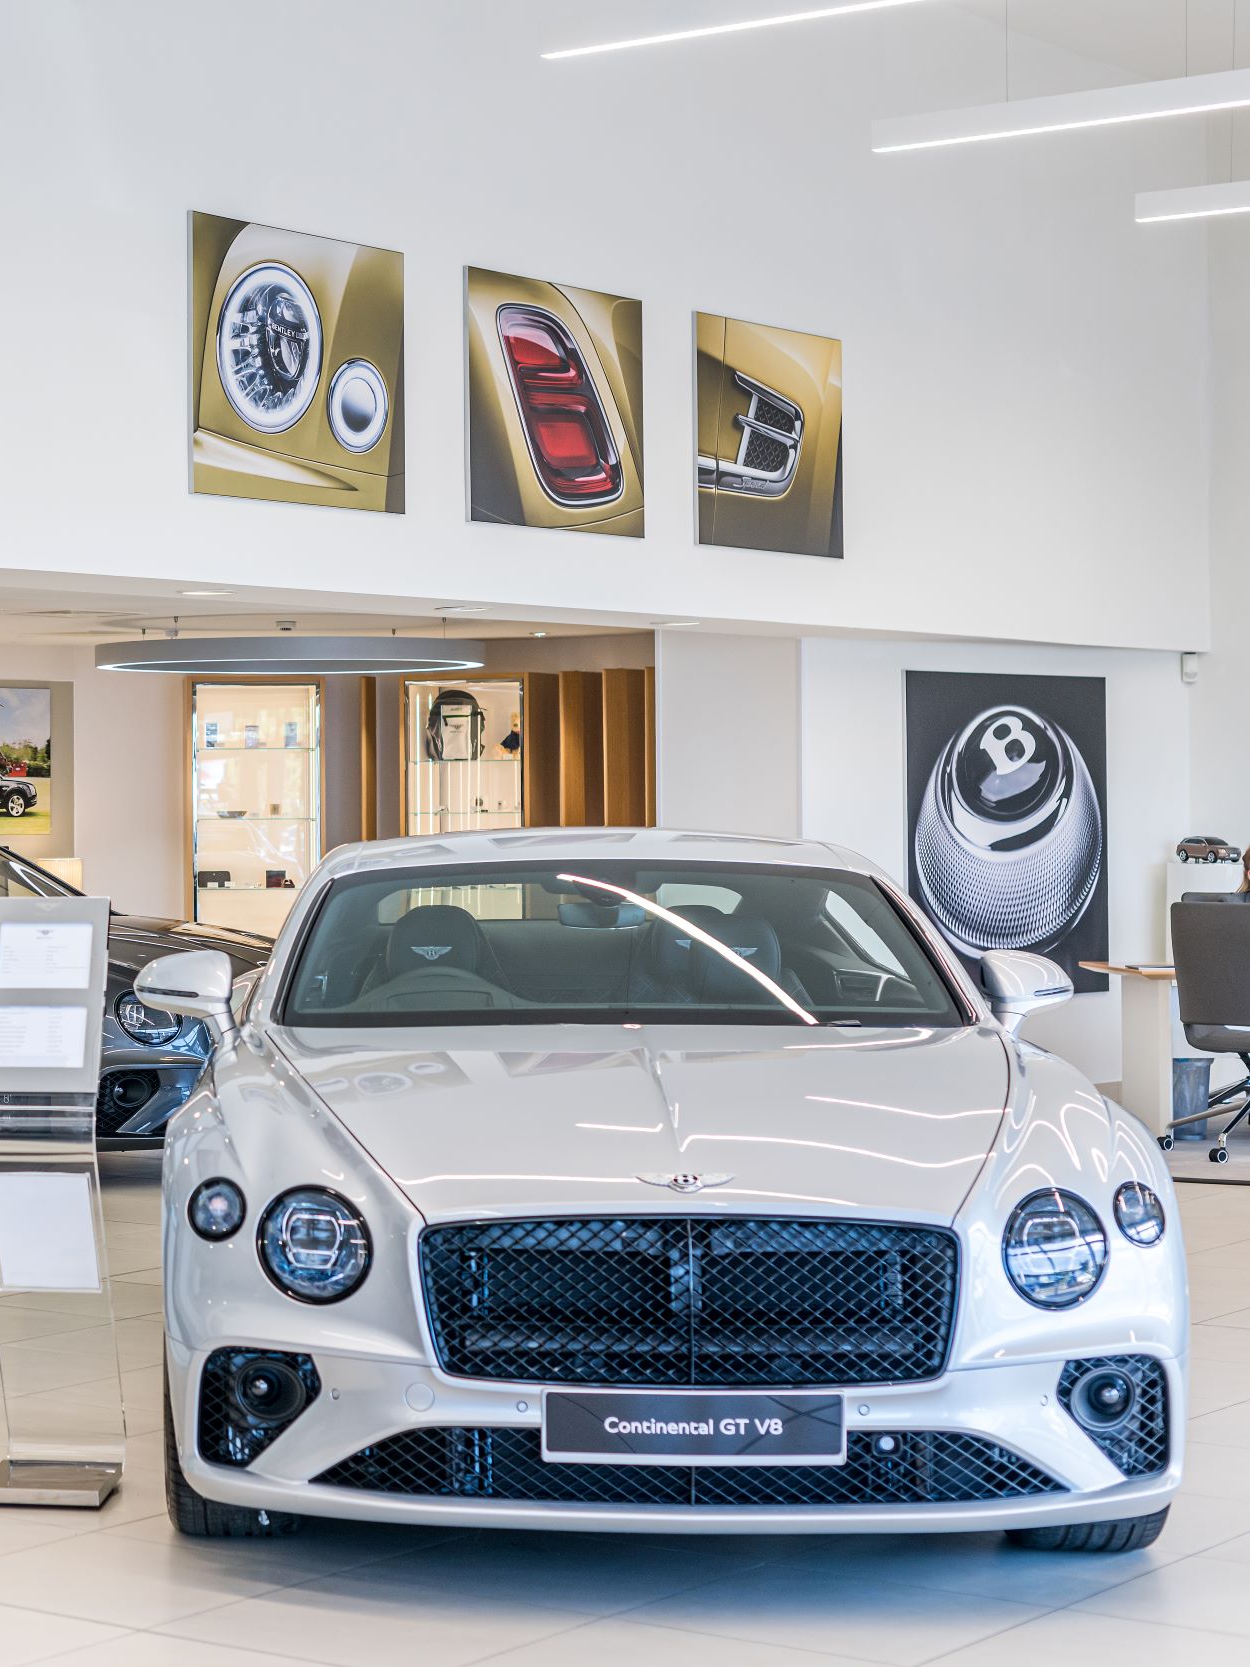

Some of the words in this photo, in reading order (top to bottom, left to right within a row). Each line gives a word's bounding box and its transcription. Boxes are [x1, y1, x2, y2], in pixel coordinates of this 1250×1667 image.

[271, 322, 296, 337] BENTLEY
[979, 715, 1037, 776] B
[603, 1416, 714, 1436] Continental
[718, 1418, 750, 1436] GT
[754, 1418, 784, 1436] V8
